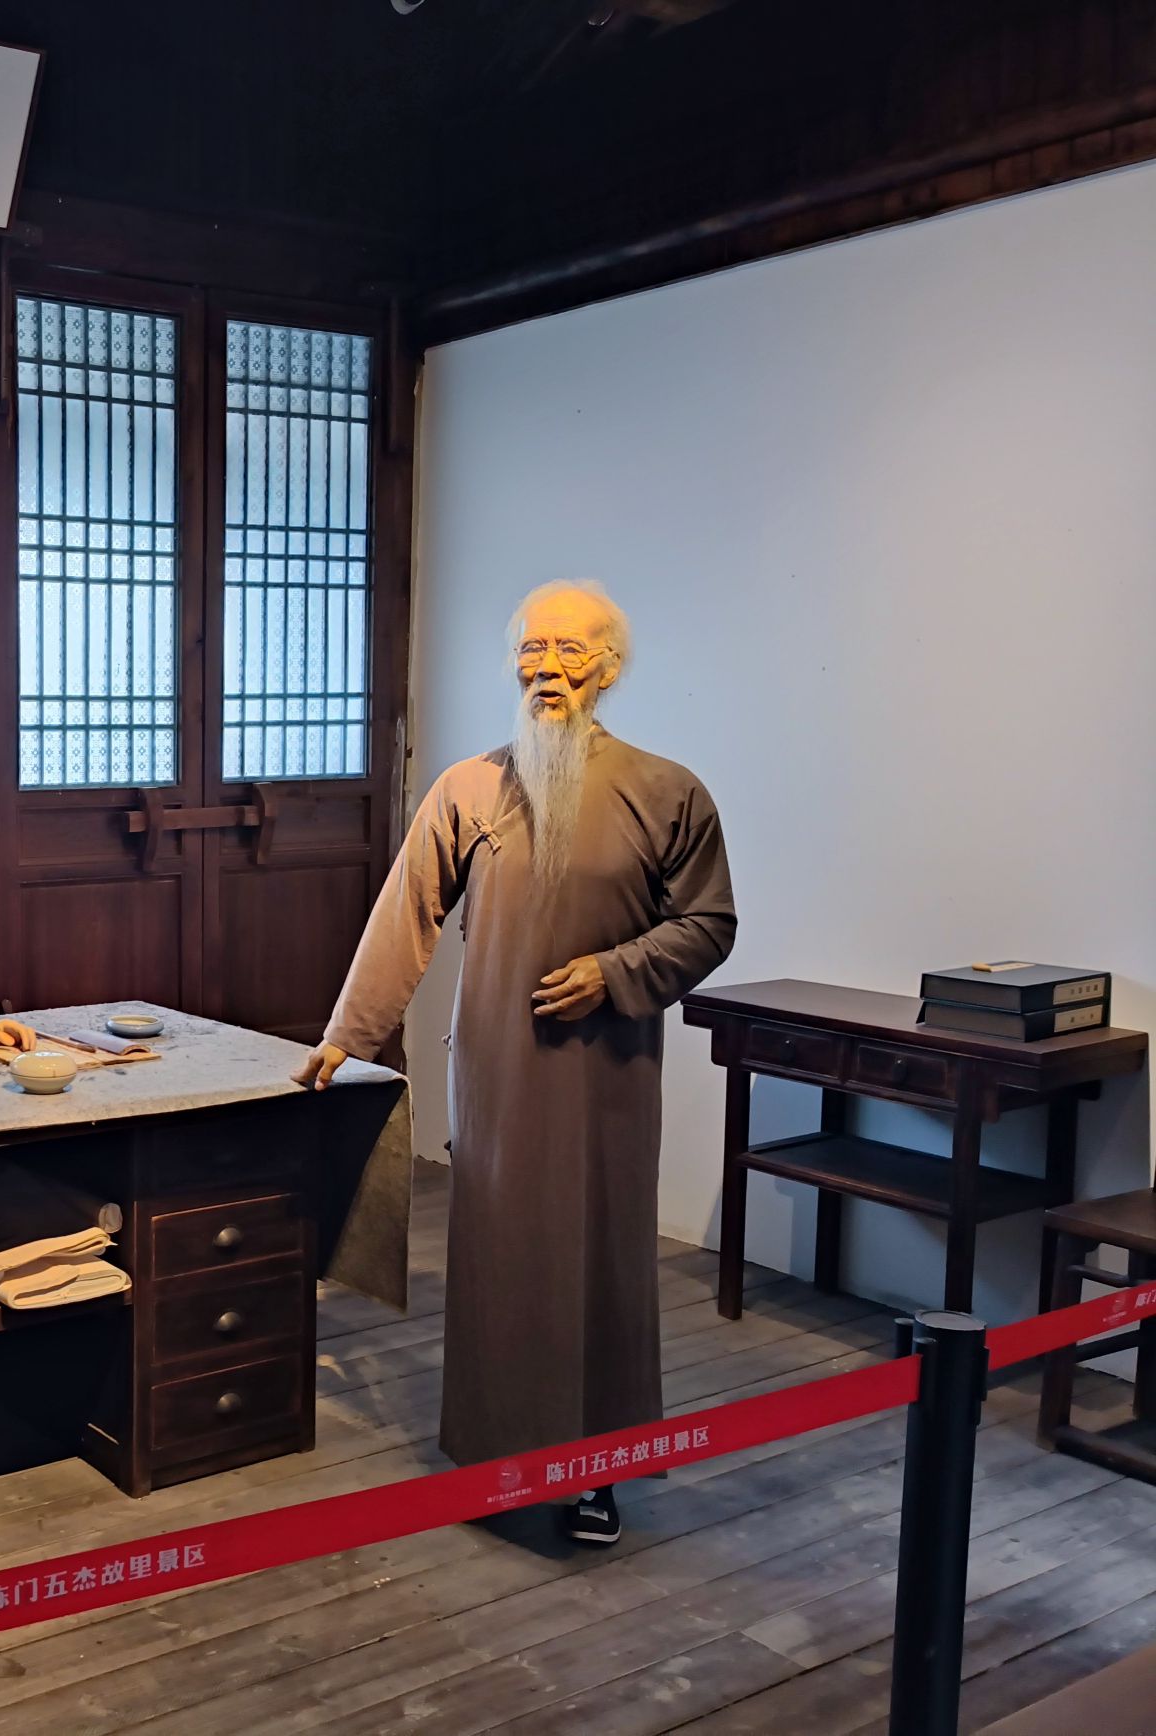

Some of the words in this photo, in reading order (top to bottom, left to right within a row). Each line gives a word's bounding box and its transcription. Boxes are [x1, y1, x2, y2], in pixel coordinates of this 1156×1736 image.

[546, 1425, 710, 1485] 陈门五杰故里景区
